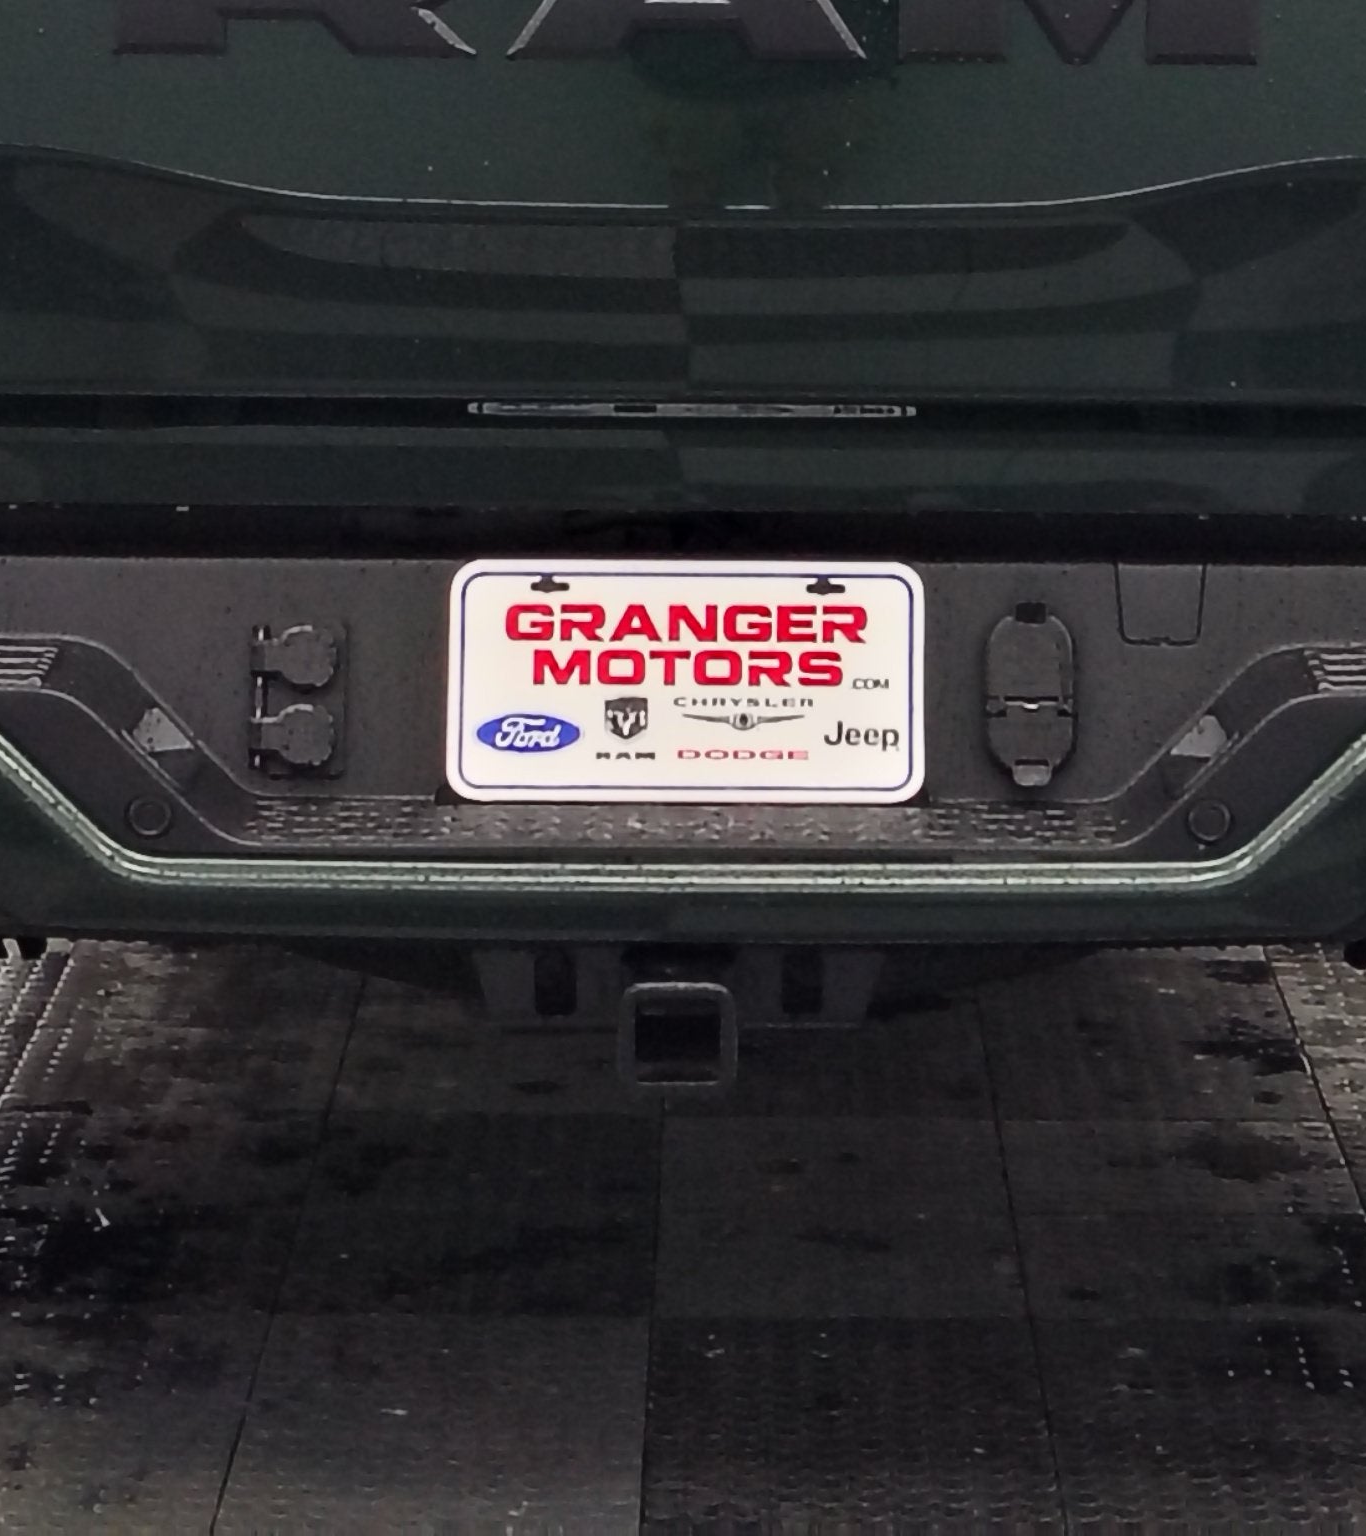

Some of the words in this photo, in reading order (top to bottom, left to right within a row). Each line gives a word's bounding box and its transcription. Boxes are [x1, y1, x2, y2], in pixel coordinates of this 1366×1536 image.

[504, 603, 868, 644] GRANGER
[532, 649, 844, 688] MOTORS
[672, 696, 814, 708] CHRYSLER
[494, 716, 563, 749] Ford
[823, 720, 900, 752] Jeep
[595, 751, 656, 761] RAM
[676, 748, 810, 761] DODGE
